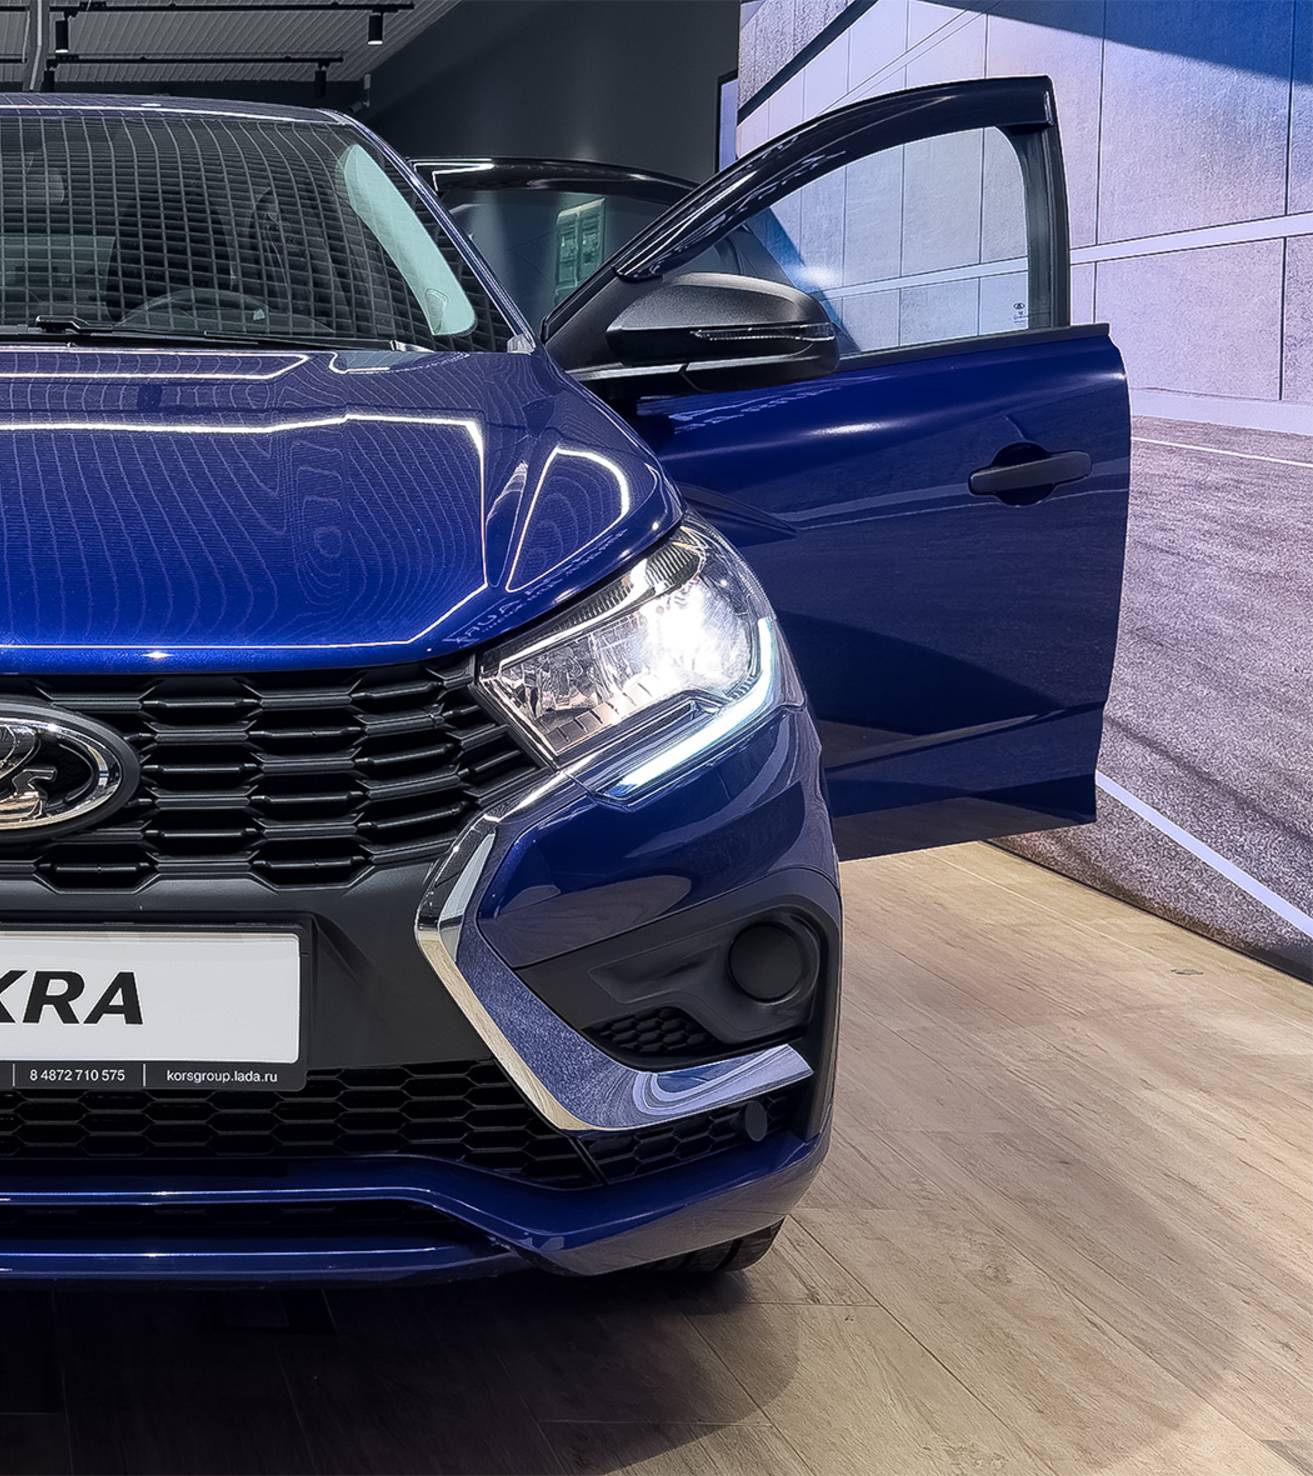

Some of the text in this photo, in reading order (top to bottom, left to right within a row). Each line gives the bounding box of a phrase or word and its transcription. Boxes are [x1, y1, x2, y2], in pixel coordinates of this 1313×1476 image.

[29, 1069, 126, 1081] 8 4872 710 575
[166, 1069, 278, 1084] korsgroup.lada.ru
